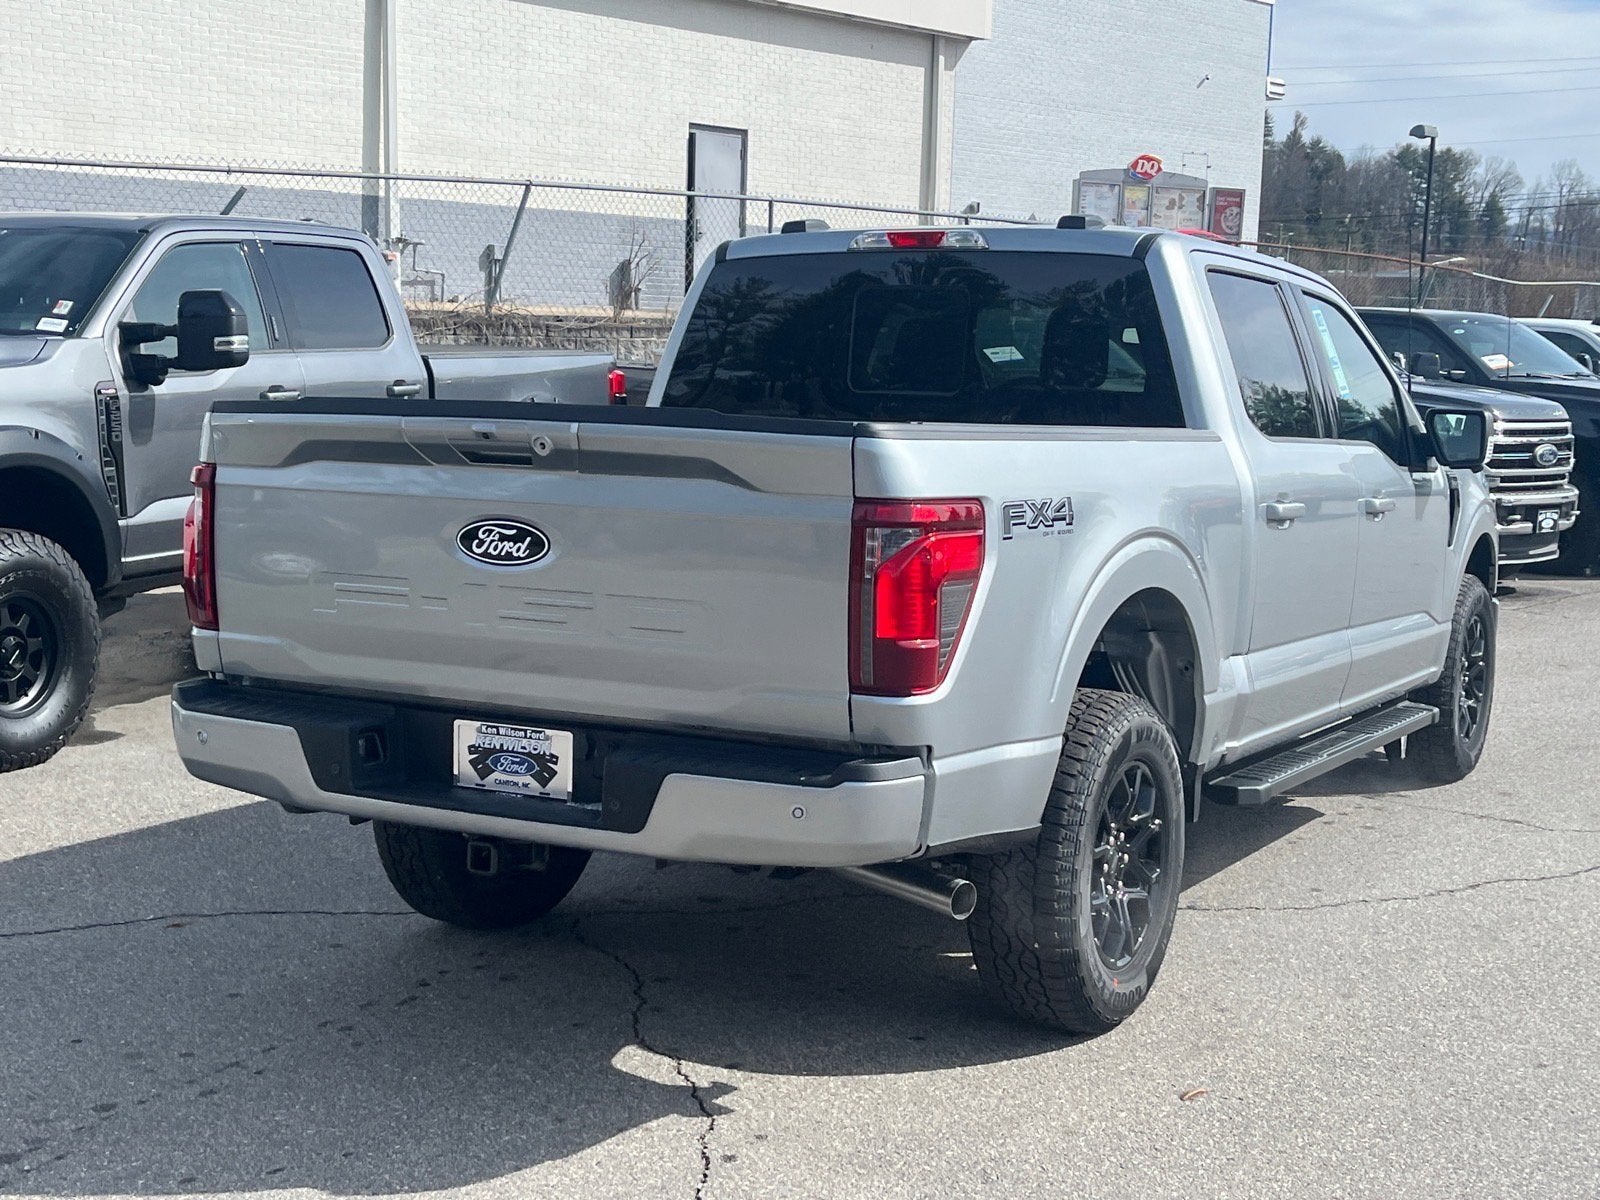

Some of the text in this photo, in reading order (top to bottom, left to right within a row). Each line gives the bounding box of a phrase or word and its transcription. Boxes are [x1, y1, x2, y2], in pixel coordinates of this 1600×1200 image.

[1136, 159, 1159, 176] DQ
[1000, 496, 1074, 540] FX4
[472, 526, 531, 557] Ford
[481, 724, 545, 740] Ken Wilson Ford
[499, 737, 552, 755] WILSON
[497, 755, 528, 774] Ford
